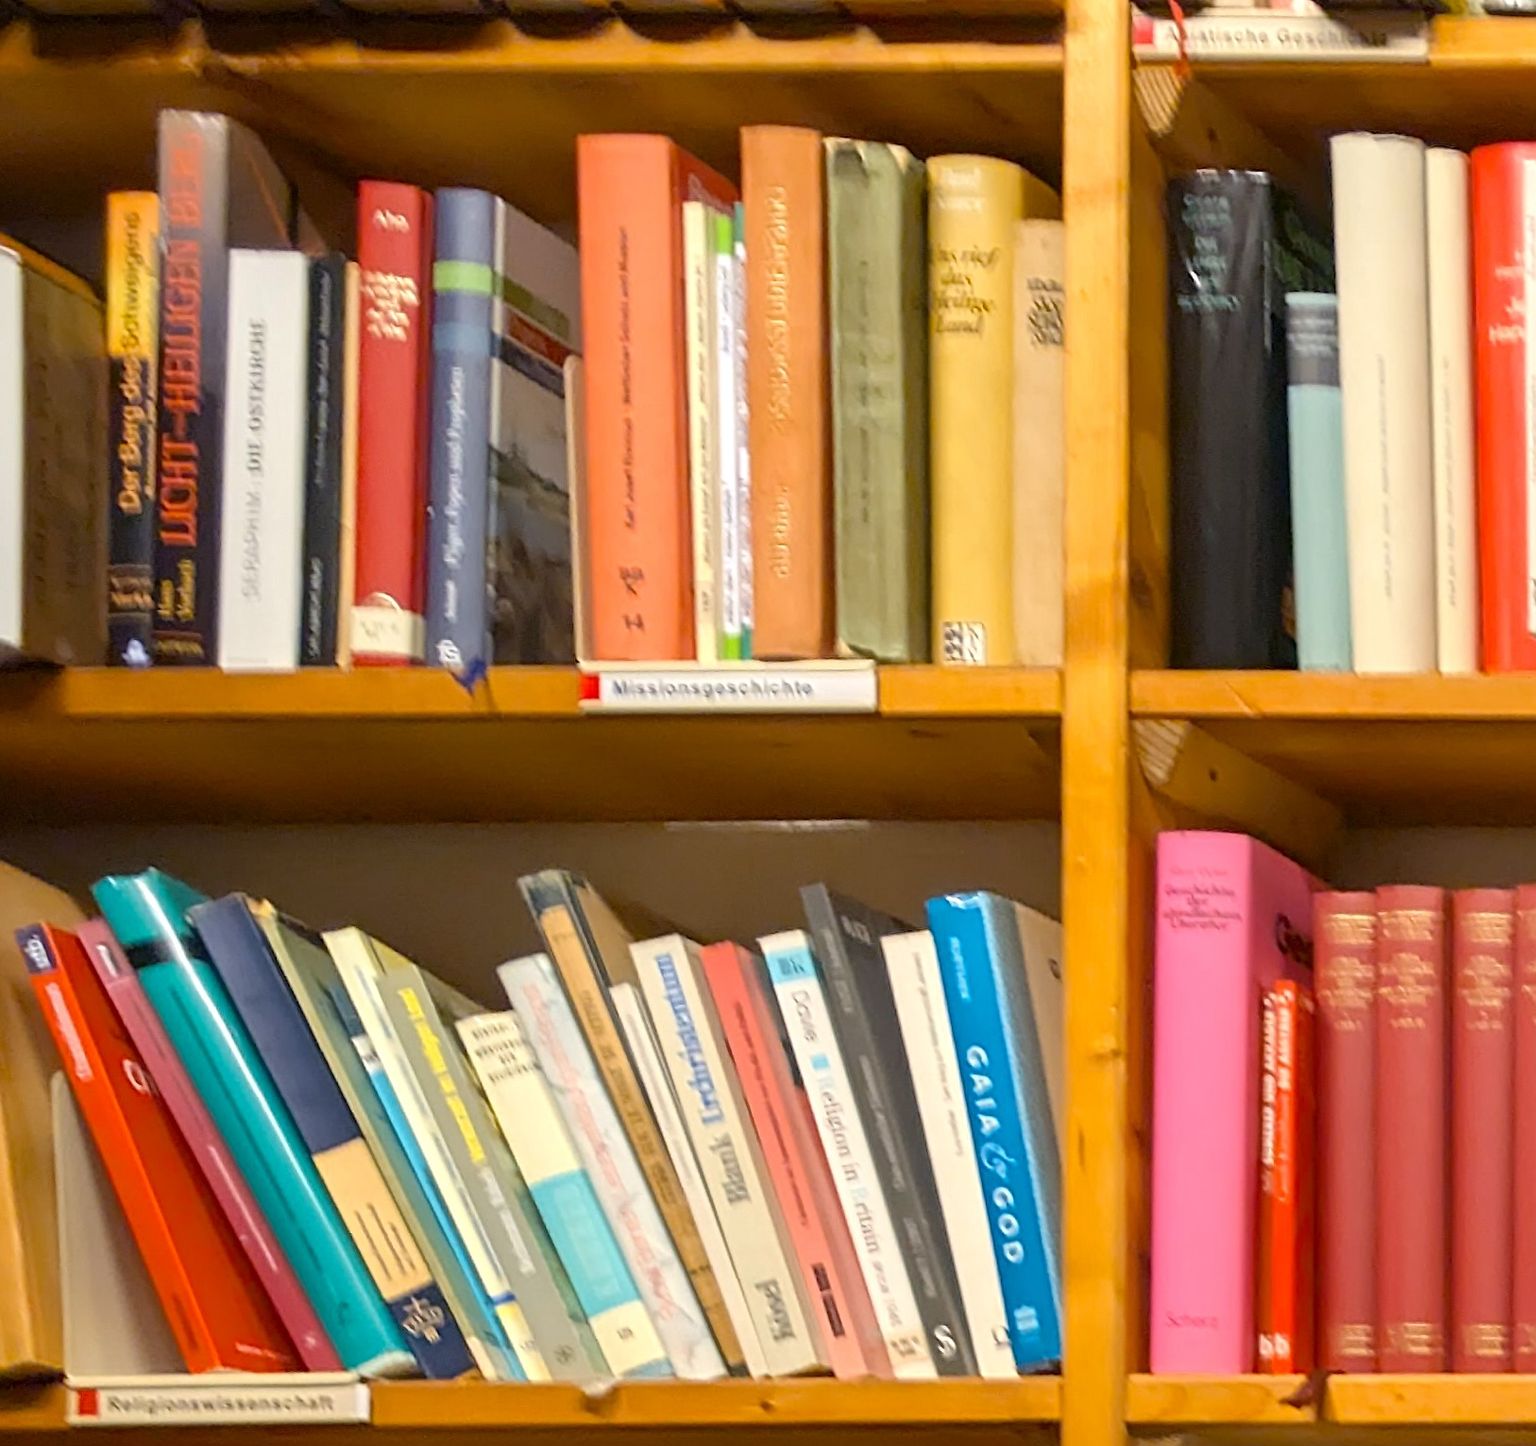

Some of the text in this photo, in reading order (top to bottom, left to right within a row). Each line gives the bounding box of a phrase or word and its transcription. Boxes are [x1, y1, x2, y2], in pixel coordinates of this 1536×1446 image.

[612, 680, 812, 698] Missionsgeschichte
[712, 1134, 751, 1203] Blank
[966, 1045, 998, 1134] GAIA
[990, 1187, 1024, 1264] GOD
